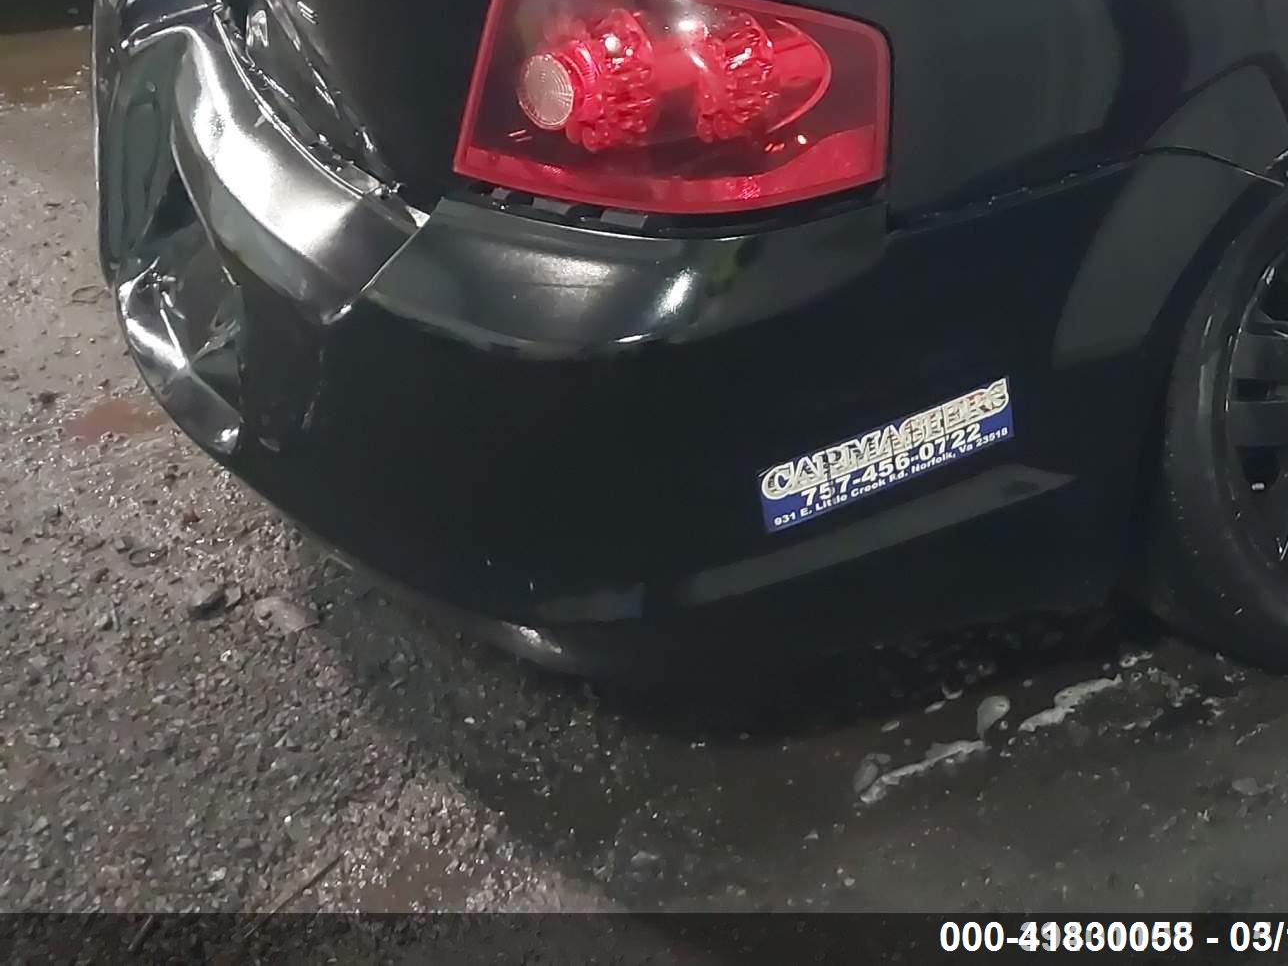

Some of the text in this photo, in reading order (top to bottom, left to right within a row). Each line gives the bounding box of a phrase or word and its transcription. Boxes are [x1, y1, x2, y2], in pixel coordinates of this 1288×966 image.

[801, 423, 982, 507] 757-456-0722
[774, 511, 797, 526] 931
[815, 494, 848, 512] Little
